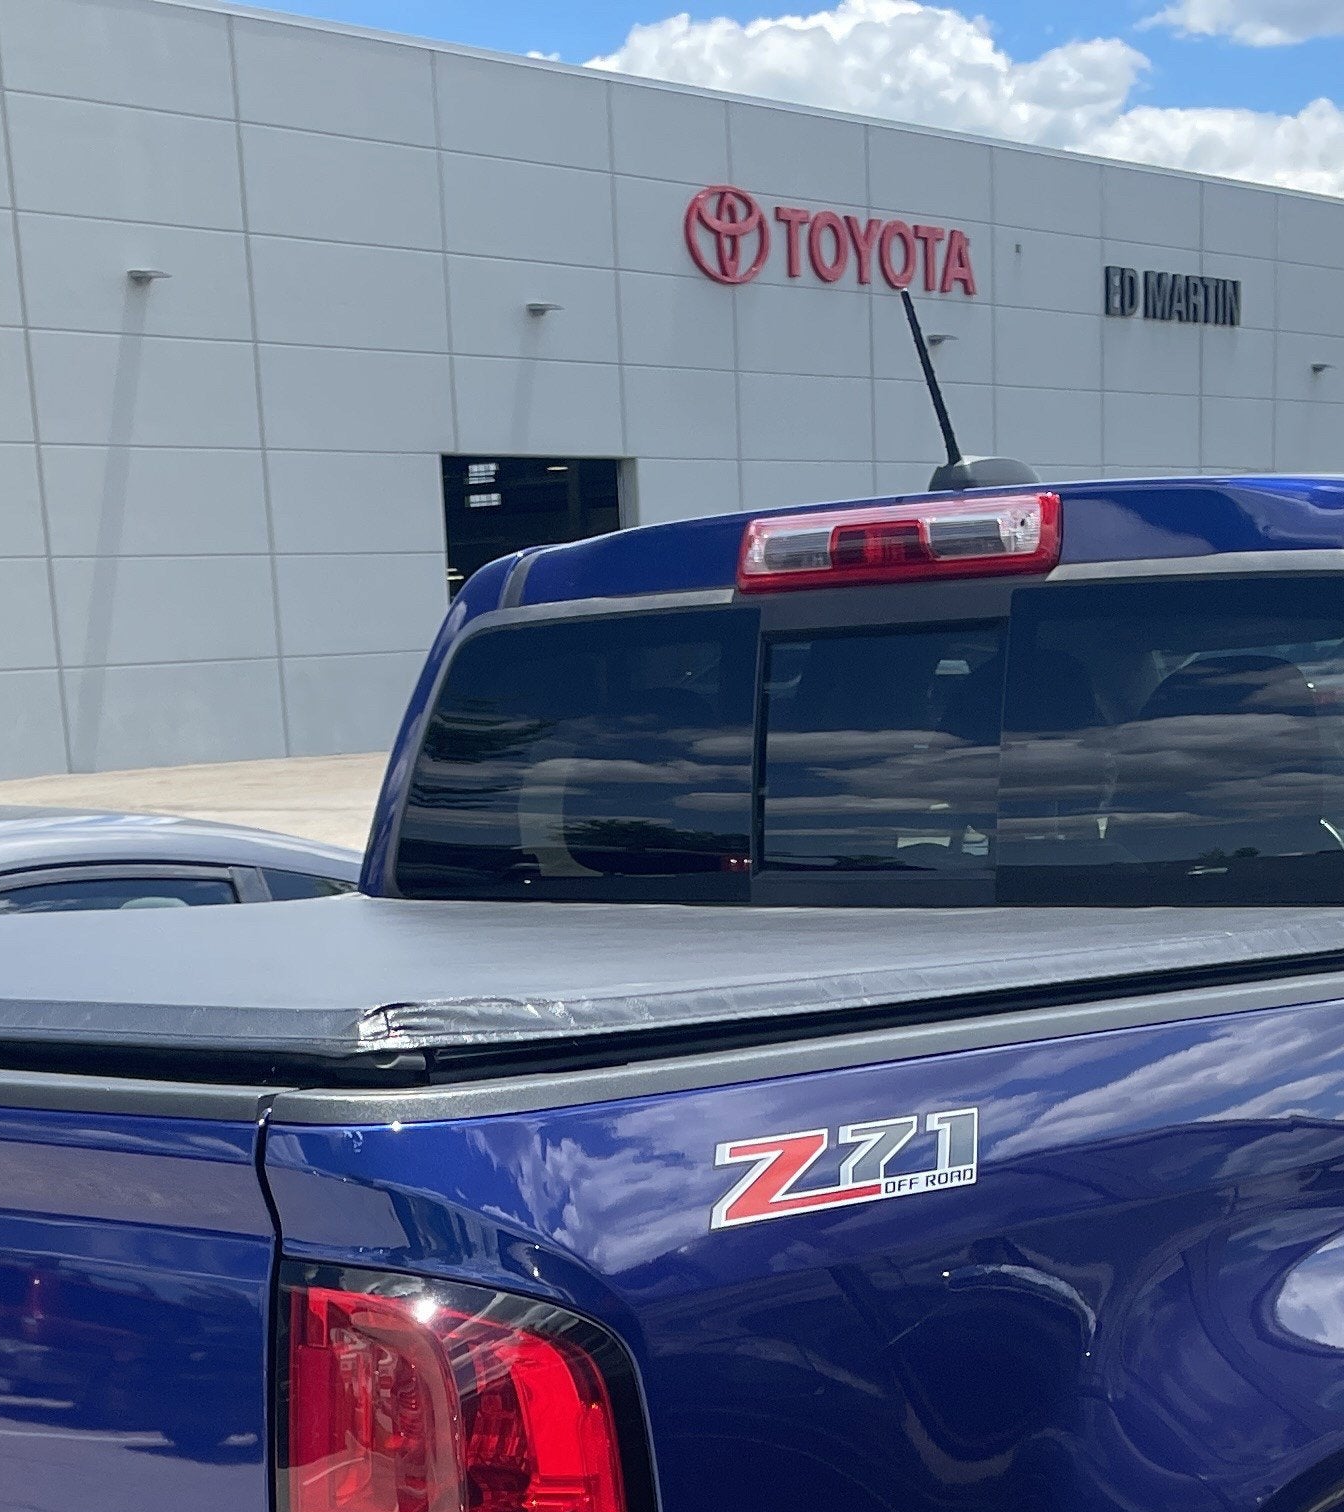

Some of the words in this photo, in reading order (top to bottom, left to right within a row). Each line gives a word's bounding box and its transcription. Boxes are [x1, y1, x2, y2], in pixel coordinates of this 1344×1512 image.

[775, 205, 977, 296] TOYOTA
[1103, 265, 1140, 318] ED
[1143, 270, 1242, 327] MARTIN
[709, 1106, 979, 1231] Z71
[884, 1179, 920, 1195] OFF
[924, 1167, 975, 1188] ROAD
